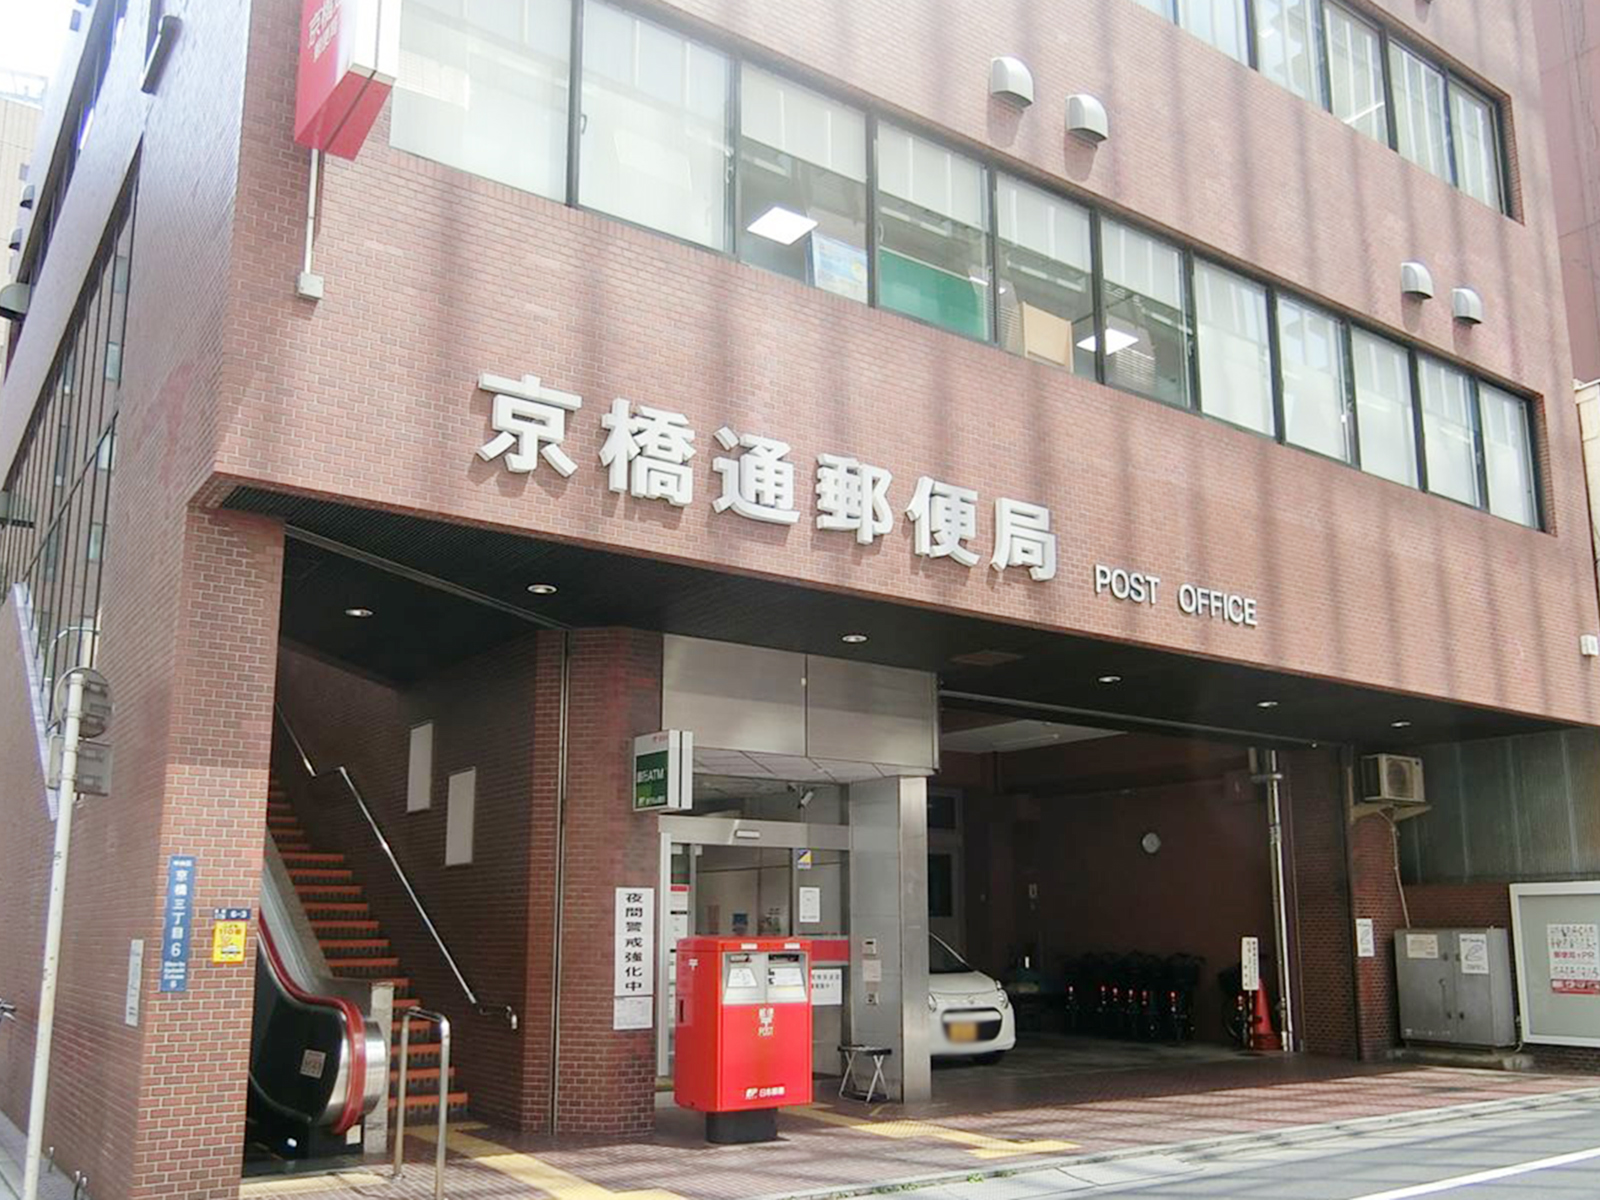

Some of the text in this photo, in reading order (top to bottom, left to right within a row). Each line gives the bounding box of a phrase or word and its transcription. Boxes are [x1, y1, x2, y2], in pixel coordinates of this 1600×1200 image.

[476, 373, 1057, 582] 京橋通郵便局
[1094, 564, 1258, 626] POST OFFICE
[625, 893, 643, 991] 夜間警戒強化中
